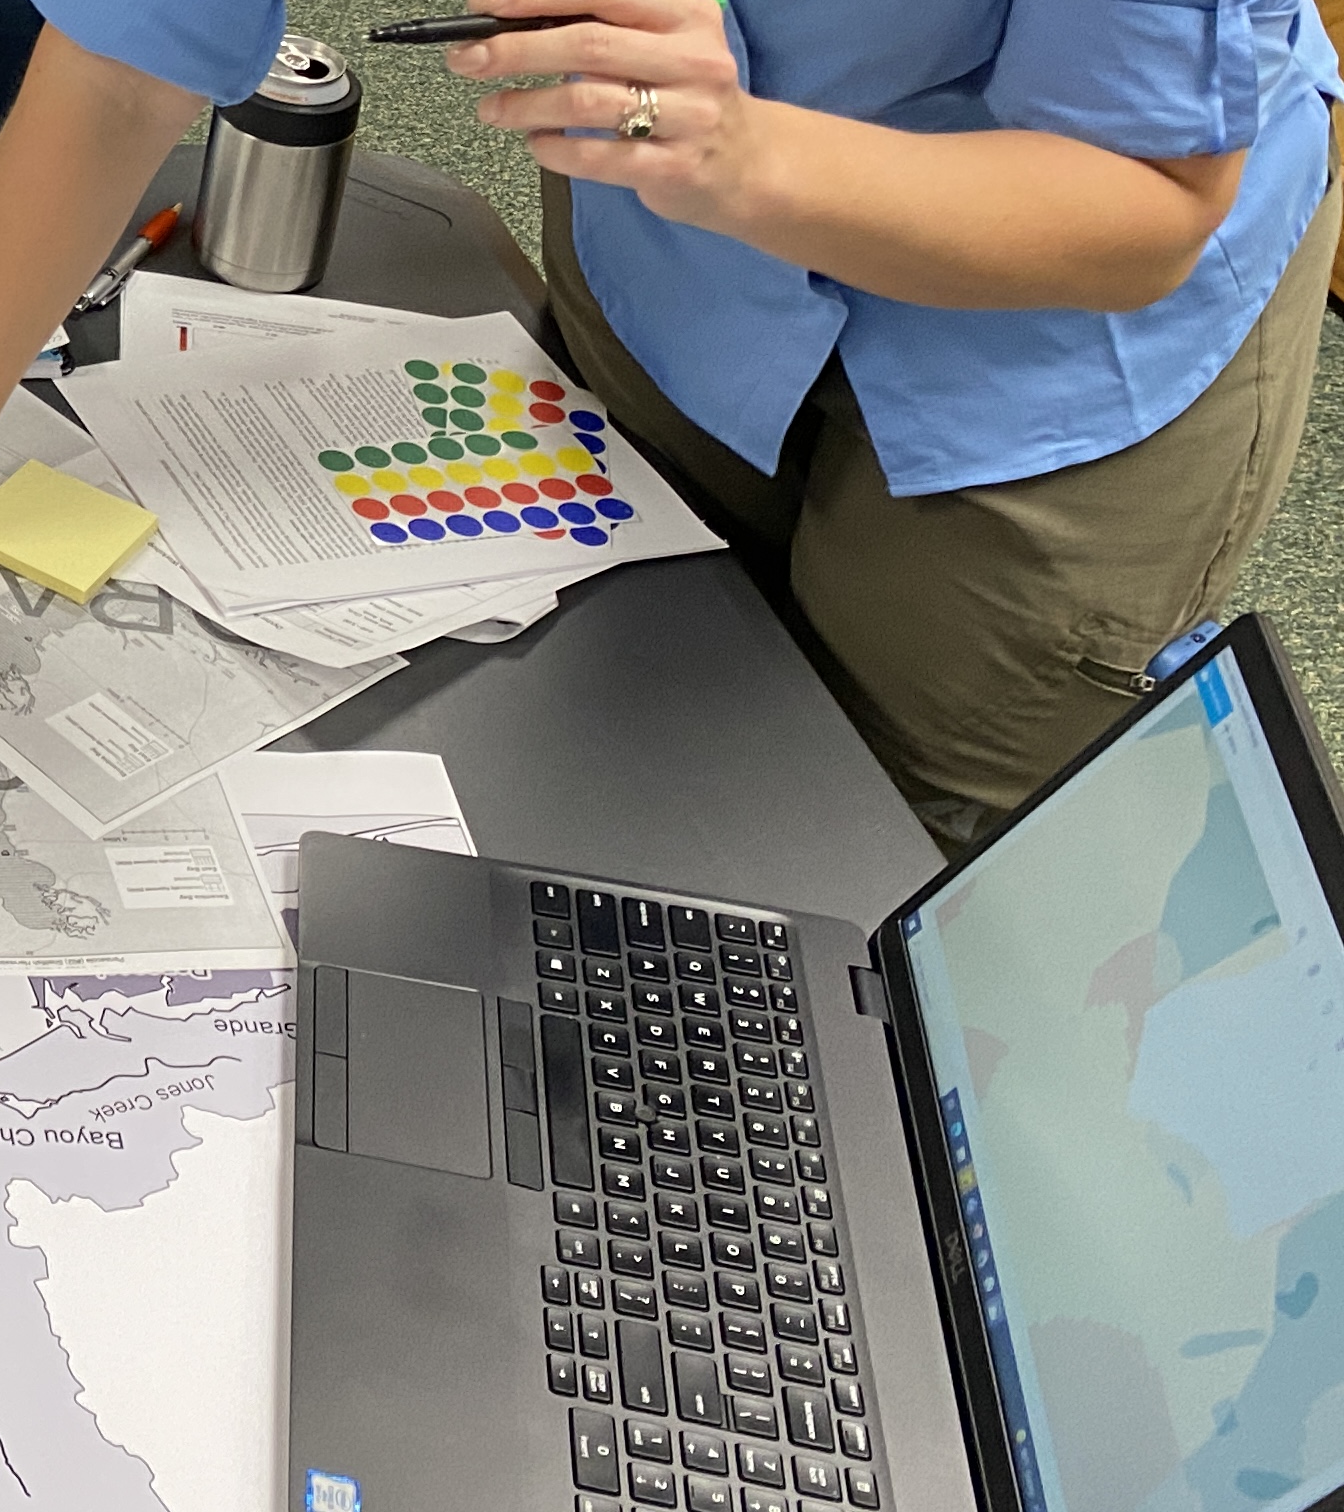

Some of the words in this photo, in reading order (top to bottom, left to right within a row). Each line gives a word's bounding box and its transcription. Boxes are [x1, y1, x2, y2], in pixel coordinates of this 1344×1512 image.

[643, 960, 655, 970] A
[689, 961, 702, 972] Q
[597, 967, 610, 978] Z
[732, 986, 744, 995] 2
[646, 993, 660, 1003] S
[694, 992, 706, 1006] W
[600, 1000, 613, 1011] X
[214, 1017, 300, 1039] Grande
[737, 1019, 749, 1028] 3
[650, 1025, 663, 1036] D
[697, 1027, 711, 1037] E
[603, 1033, 616, 1043] C
[743, 1053, 754, 1062] 4
[654, 1060, 667, 1070] F
[702, 1060, 715, 1071] R
[607, 1068, 620, 1078] V
[156, 1075, 215, 1101] Jones
[747, 1087, 759, 1096] 5
[658, 1094, 672, 1104] G
[707, 1096, 720, 1106] T
[87, 1093, 154, 1122] Creek
[609, 1102, 623, 1113] B
[752, 1122, 765, 1132] 6
[45, 1126, 123, 1149] Bayou
[662, 1129, 676, 1141] H
[712, 1132, 725, 1142] Y
[613, 1137, 626, 1150] N
[758, 1159, 770, 1169] 7
[666, 1167, 680, 1178] J
[716, 1167, 730, 1179] U
[617, 1174, 630, 1188] M
[763, 1196, 776, 1206] 8
[670, 1204, 684, 1215] K
[769, 1234, 782, 1245] 9
[674, 1243, 688, 1253] L
[726, 1244, 740, 1256] O
[945, 1231, 965, 1285] DELL
[774, 1274, 787, 1285] 0
[731, 1284, 745, 1296] P
